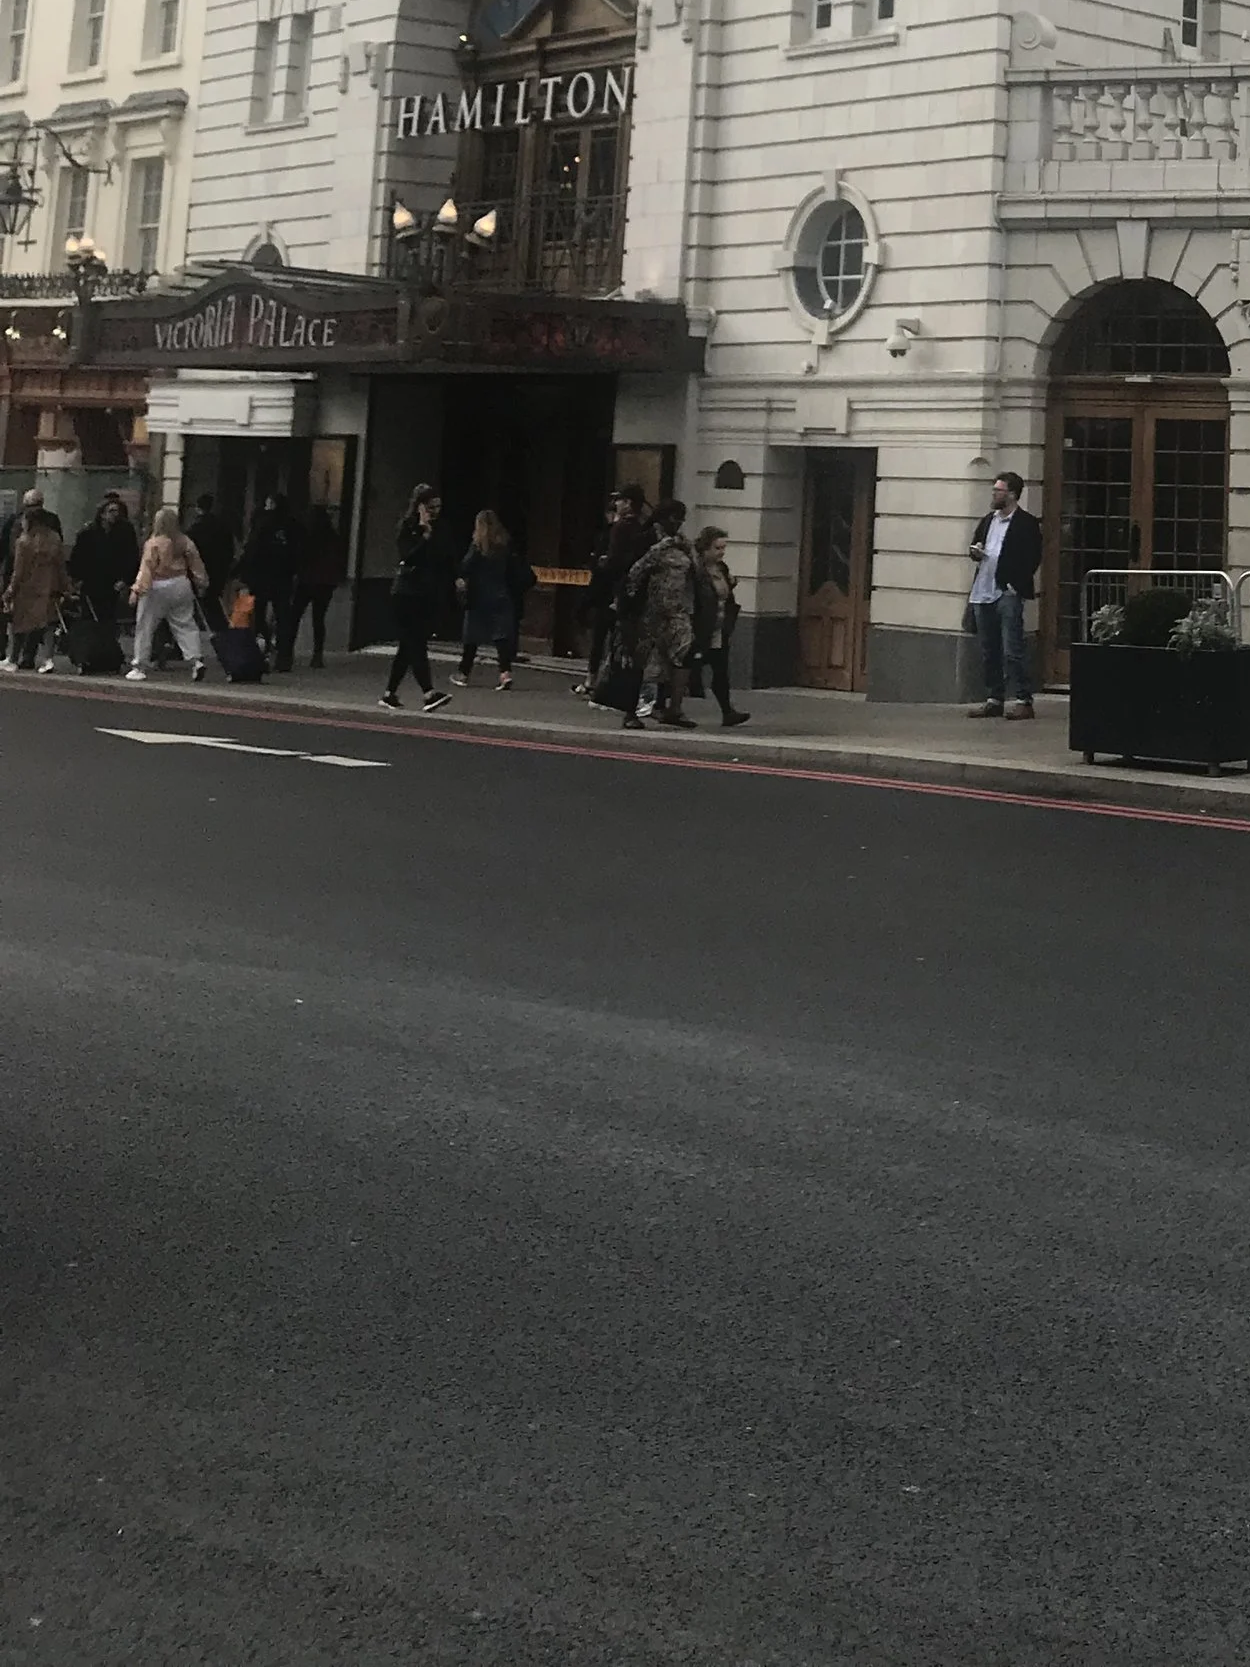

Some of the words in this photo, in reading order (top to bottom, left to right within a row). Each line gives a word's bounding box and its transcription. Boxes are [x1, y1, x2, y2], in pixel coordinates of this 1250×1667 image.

[397, 65, 633, 140] HAMILTON
[155, 295, 237, 350] VICTORIA
[249, 294, 338, 348] PALACE
